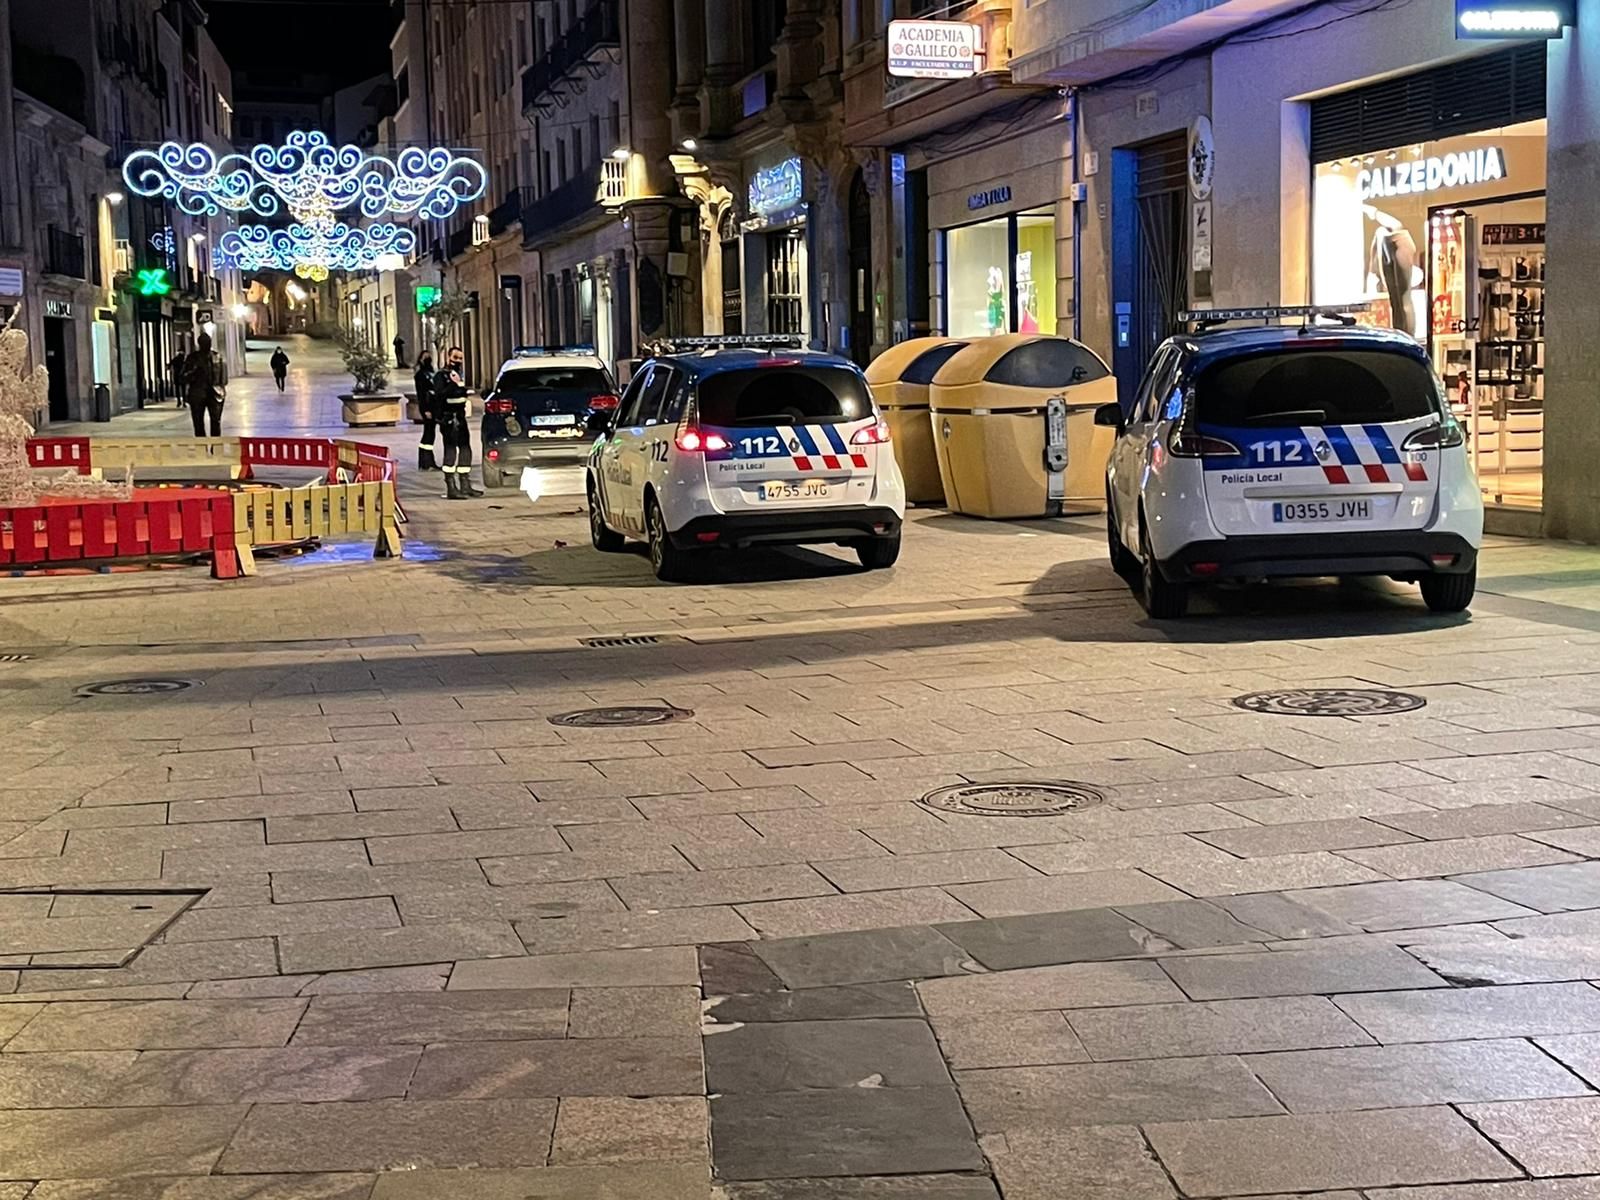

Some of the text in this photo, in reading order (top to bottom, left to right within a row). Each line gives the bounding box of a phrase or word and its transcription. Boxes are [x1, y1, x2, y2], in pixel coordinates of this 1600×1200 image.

[899, 27, 965, 43] ACADEMIA
[905, 43, 958, 58] GALILEO
[1356, 147, 1507, 200] CALZEDONIA
[651, 440, 669, 462] 112
[740, 436, 780, 454] 112
[1250, 440, 1303, 463] 112
[746, 462, 765, 470] Local
[1257, 472, 1282, 482] Local
[768, 484, 828, 498] 4755 JVG
[1285, 501, 1368, 520] 0355 JVH
